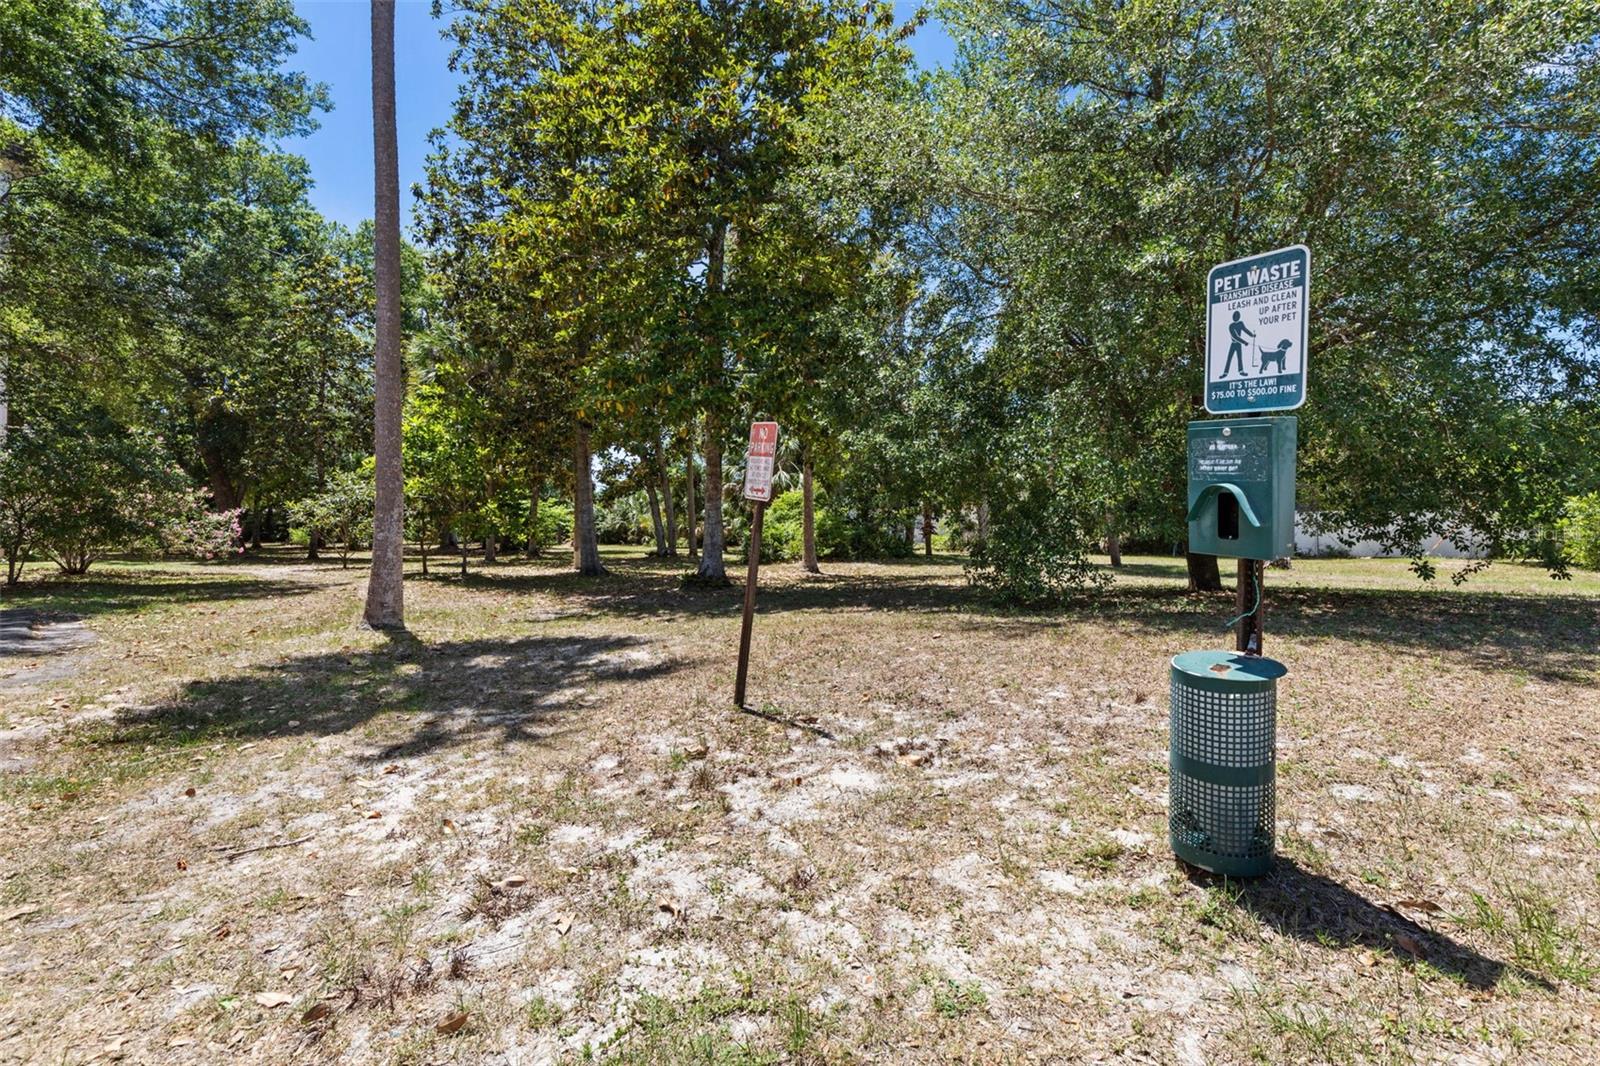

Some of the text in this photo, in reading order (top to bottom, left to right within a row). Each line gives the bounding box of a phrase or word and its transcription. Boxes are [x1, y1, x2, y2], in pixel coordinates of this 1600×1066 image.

[1214, 260, 1300, 293] PET WASTE
[1219, 280, 1294, 303] TRANSMITS DISEASE
[1227, 290, 1298, 311] LEASH AND CLEAN
[1259, 301, 1297, 315] UP AFTER
[1258, 312, 1297, 325] YOUR PET
[1229, 377, 1277, 390] IT'S THE LAW!
[1211, 384, 1297, 400] $75.00 TO $500.00 FINE
[759, 427, 769, 440] NO
[750, 442, 775, 455] PARKING
